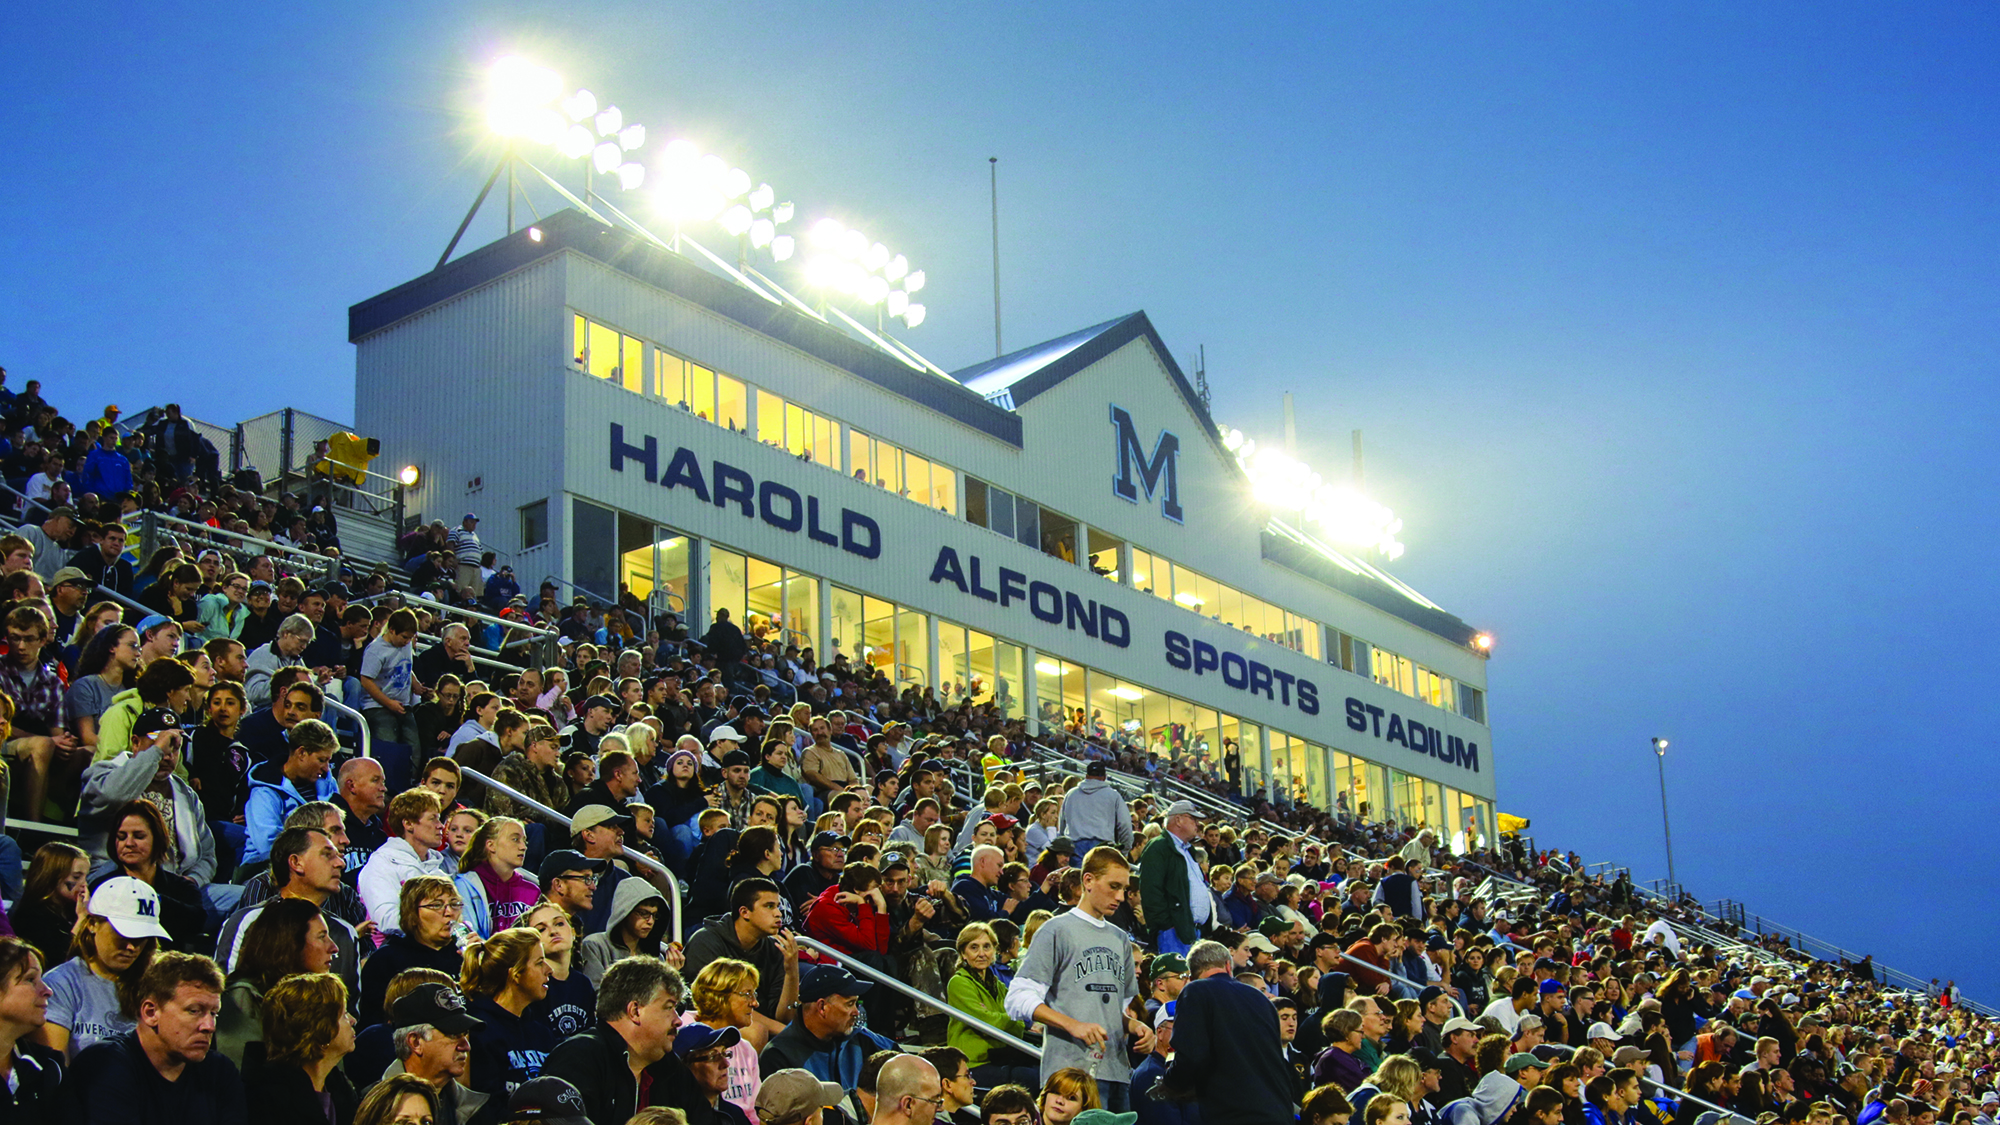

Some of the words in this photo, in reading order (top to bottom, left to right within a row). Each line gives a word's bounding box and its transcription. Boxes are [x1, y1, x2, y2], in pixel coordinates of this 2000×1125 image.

[1110, 402, 1184, 525] M
[610, 422, 881, 559] HAROLD
[929, 545, 1131, 648] ALFOND
[1164, 630, 1320, 716] SPORTS
[1345, 697, 1479, 773] STADIUM
[137, 898, 156, 917] M
[489, 901, 531, 918] MAIN
[724, 1083, 752, 1100] AINE
